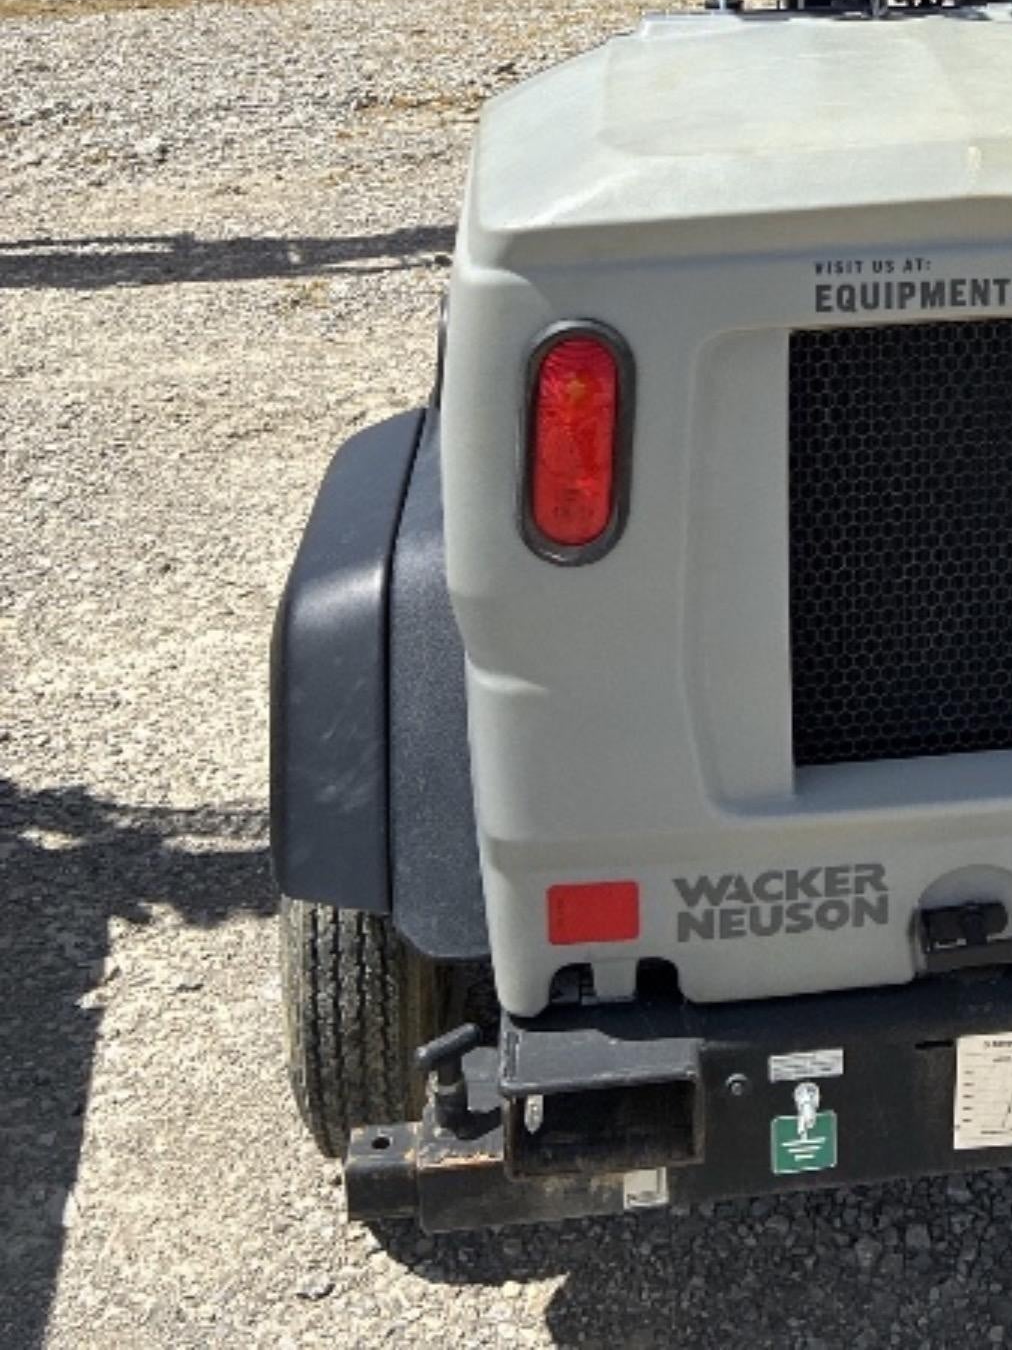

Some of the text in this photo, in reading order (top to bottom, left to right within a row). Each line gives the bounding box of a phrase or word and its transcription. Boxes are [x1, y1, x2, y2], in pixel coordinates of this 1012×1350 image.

[814, 257, 932, 275] VISIT US AT:
[672, 862, 888, 908] WACKER
[675, 893, 890, 943] NEUSON
